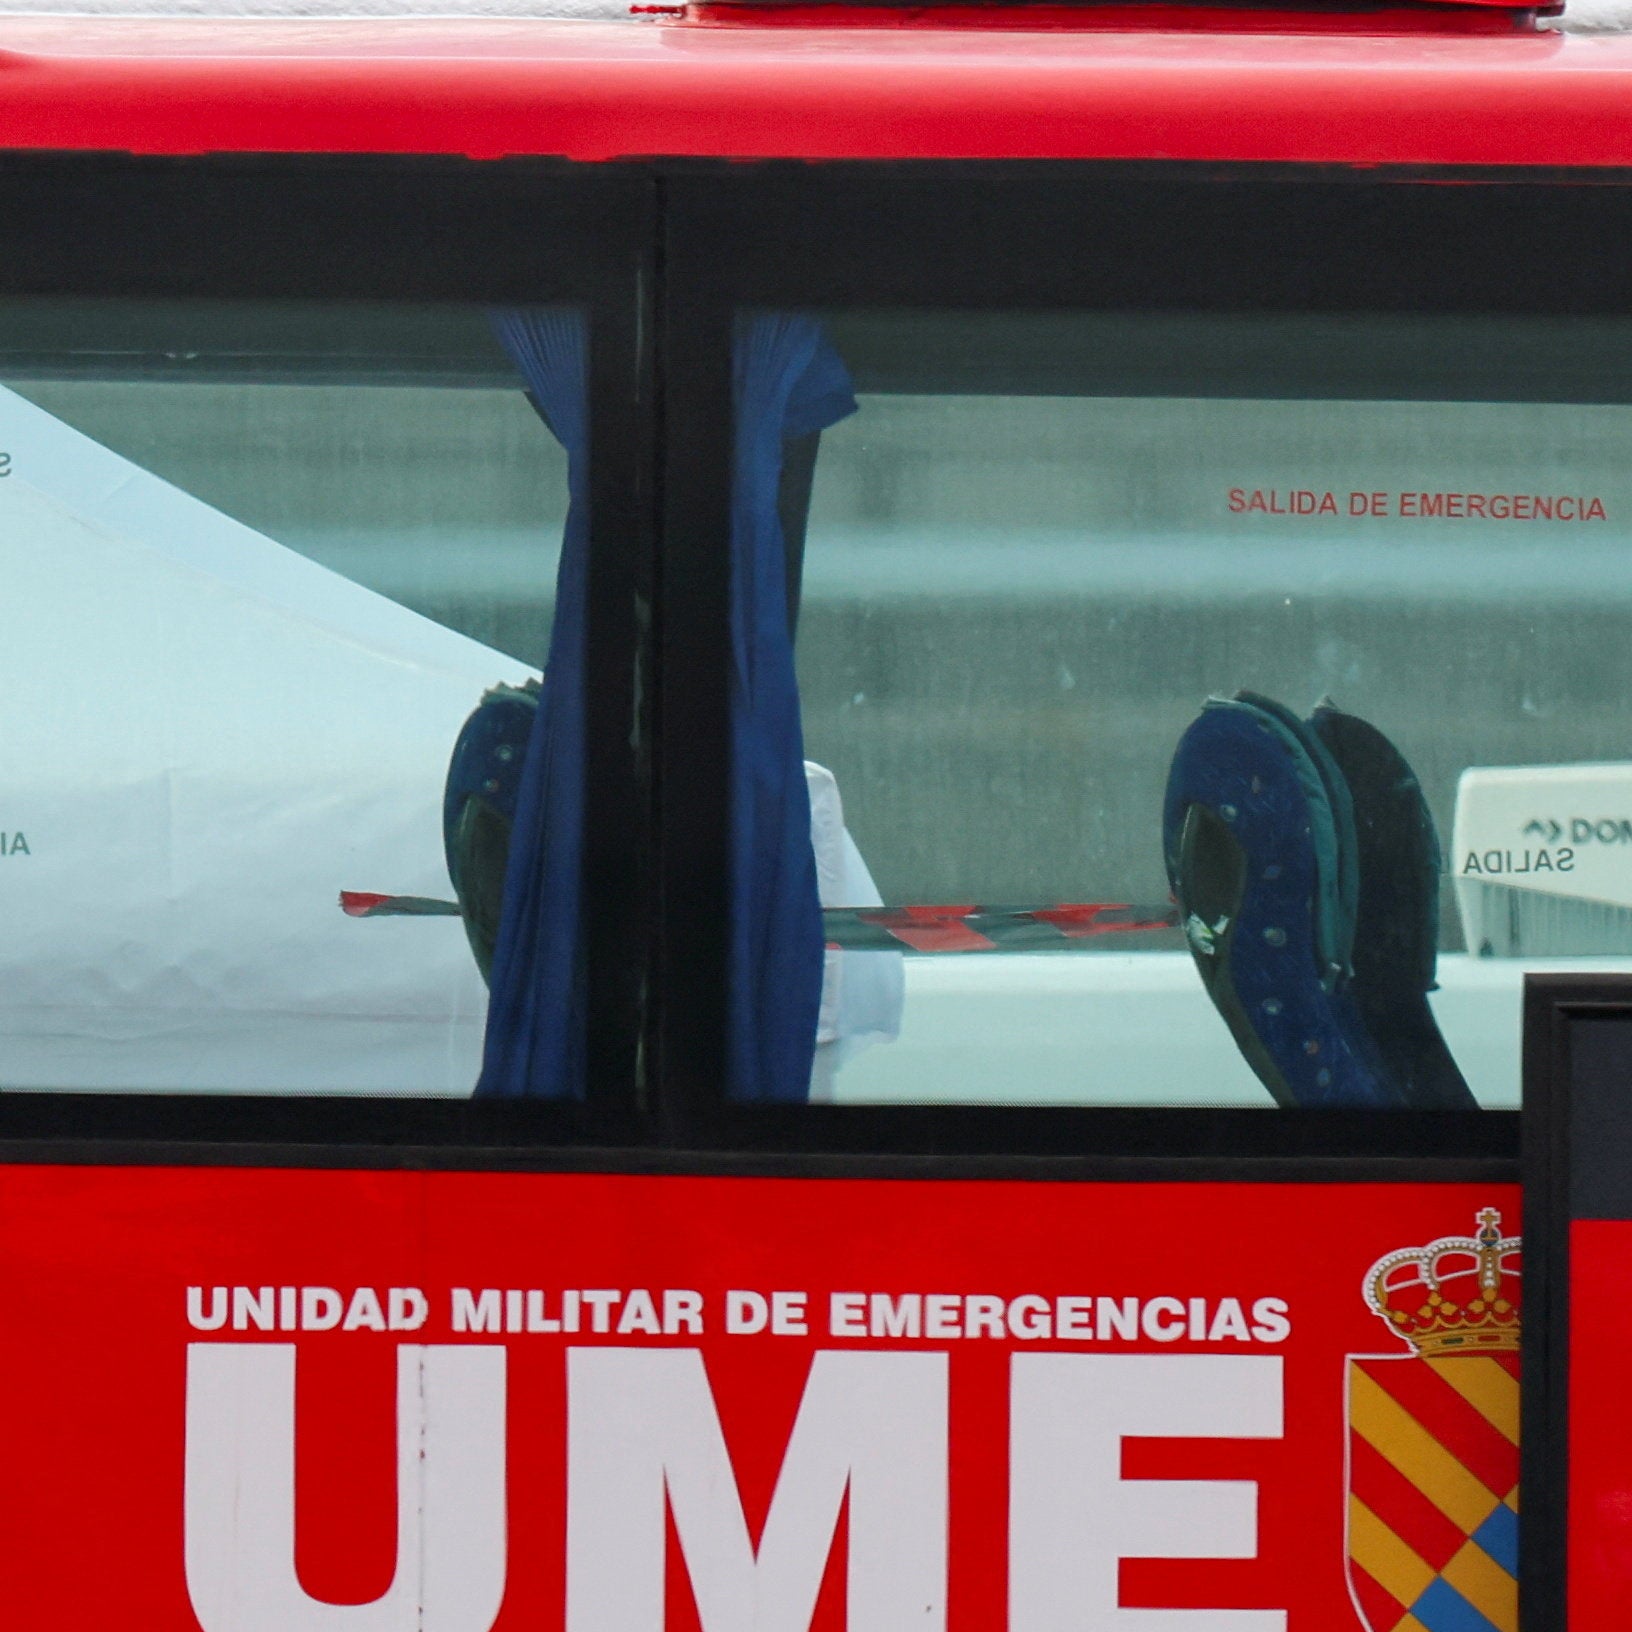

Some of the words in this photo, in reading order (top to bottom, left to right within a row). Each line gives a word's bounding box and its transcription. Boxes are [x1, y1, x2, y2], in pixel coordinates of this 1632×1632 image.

[1228, 489, 1338, 514] SALIDA
[1349, 492, 1388, 516] DE
[1399, 493, 1607, 521] EMERGENCIA
[186, 1286, 429, 1332] UNIDAD
[451, 1288, 704, 1335] MILITAR
[726, 1290, 808, 1336] DE
[829, 1292, 1291, 1343] EMERGENCIAS
